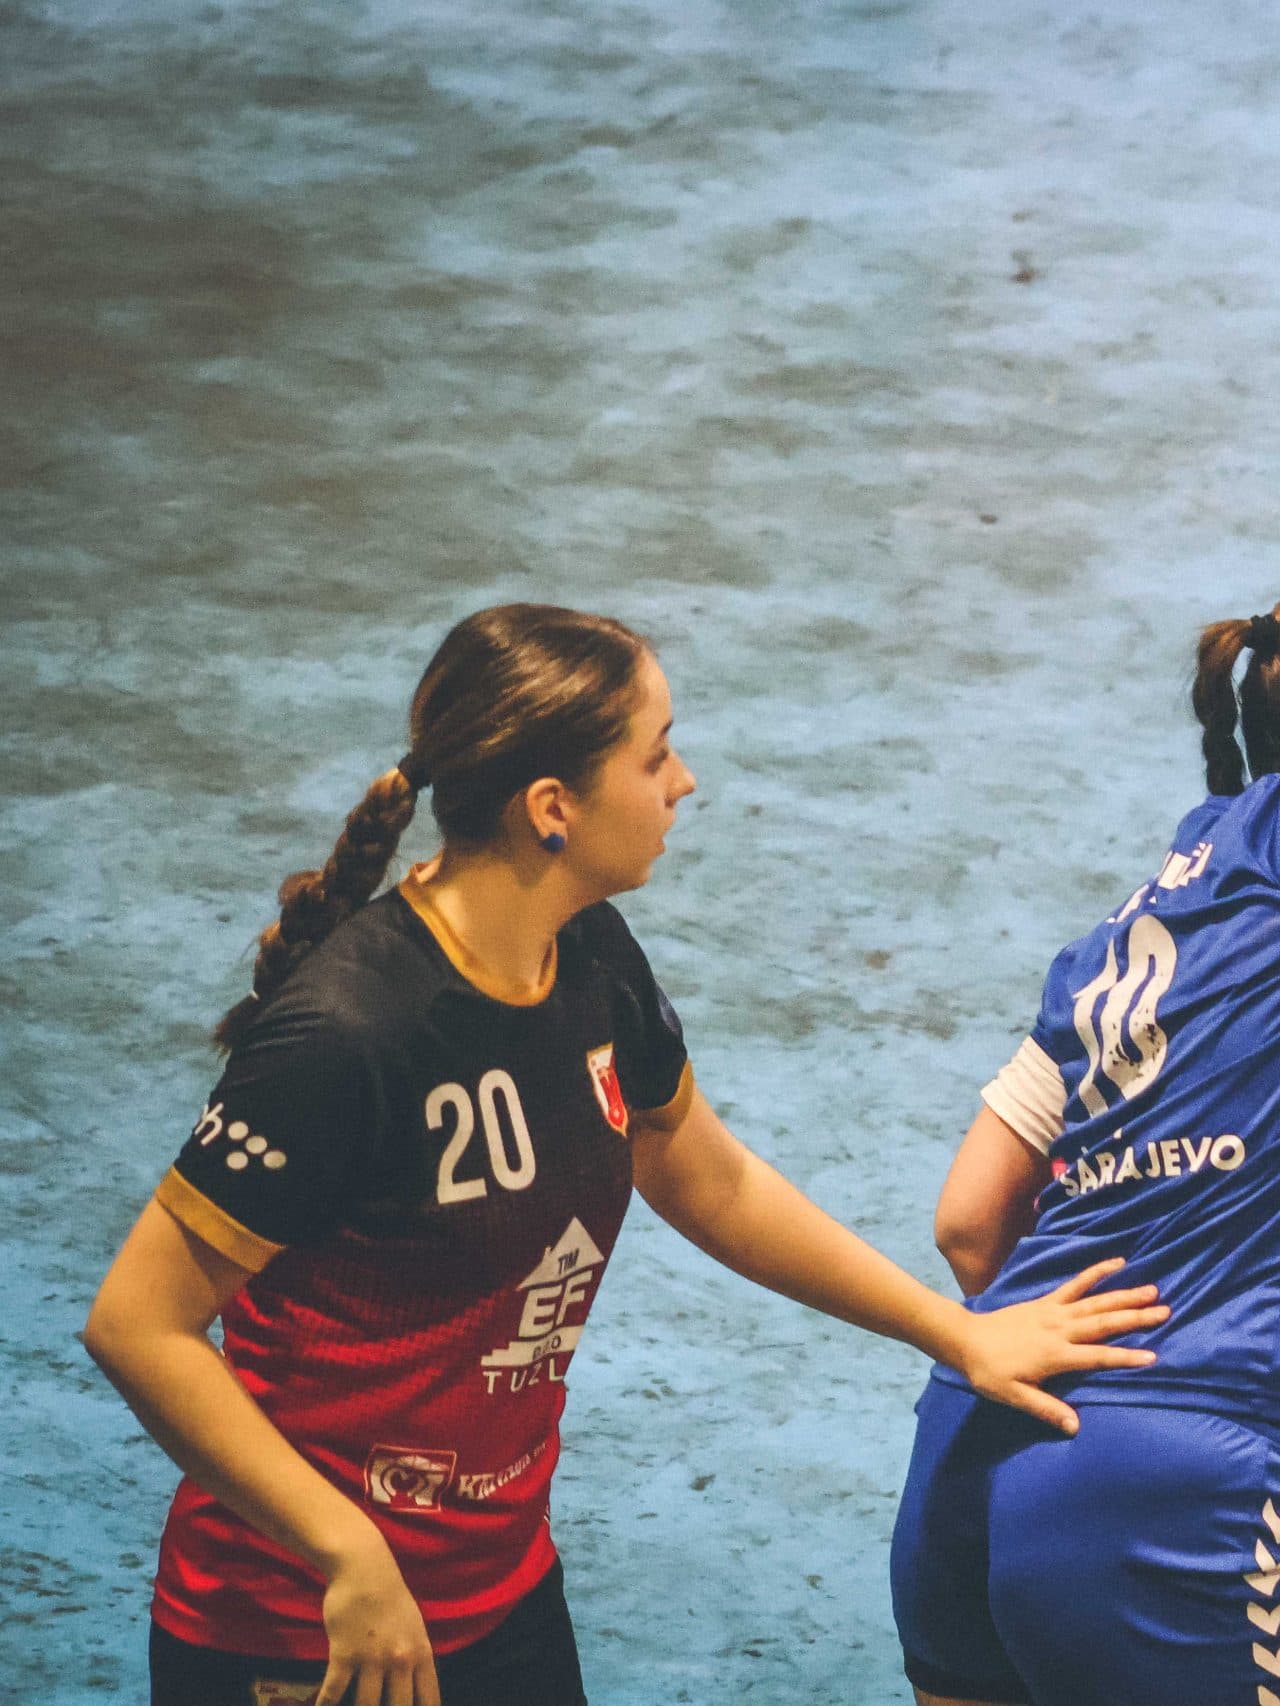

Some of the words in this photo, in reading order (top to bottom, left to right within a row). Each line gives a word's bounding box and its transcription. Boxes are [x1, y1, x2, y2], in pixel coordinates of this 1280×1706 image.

[425, 1069, 536, 1204] 20
[1059, 1134, 1246, 1197] SARAJEVO
[558, 1249, 580, 1275] TIM
[518, 1270, 593, 1338] EF
